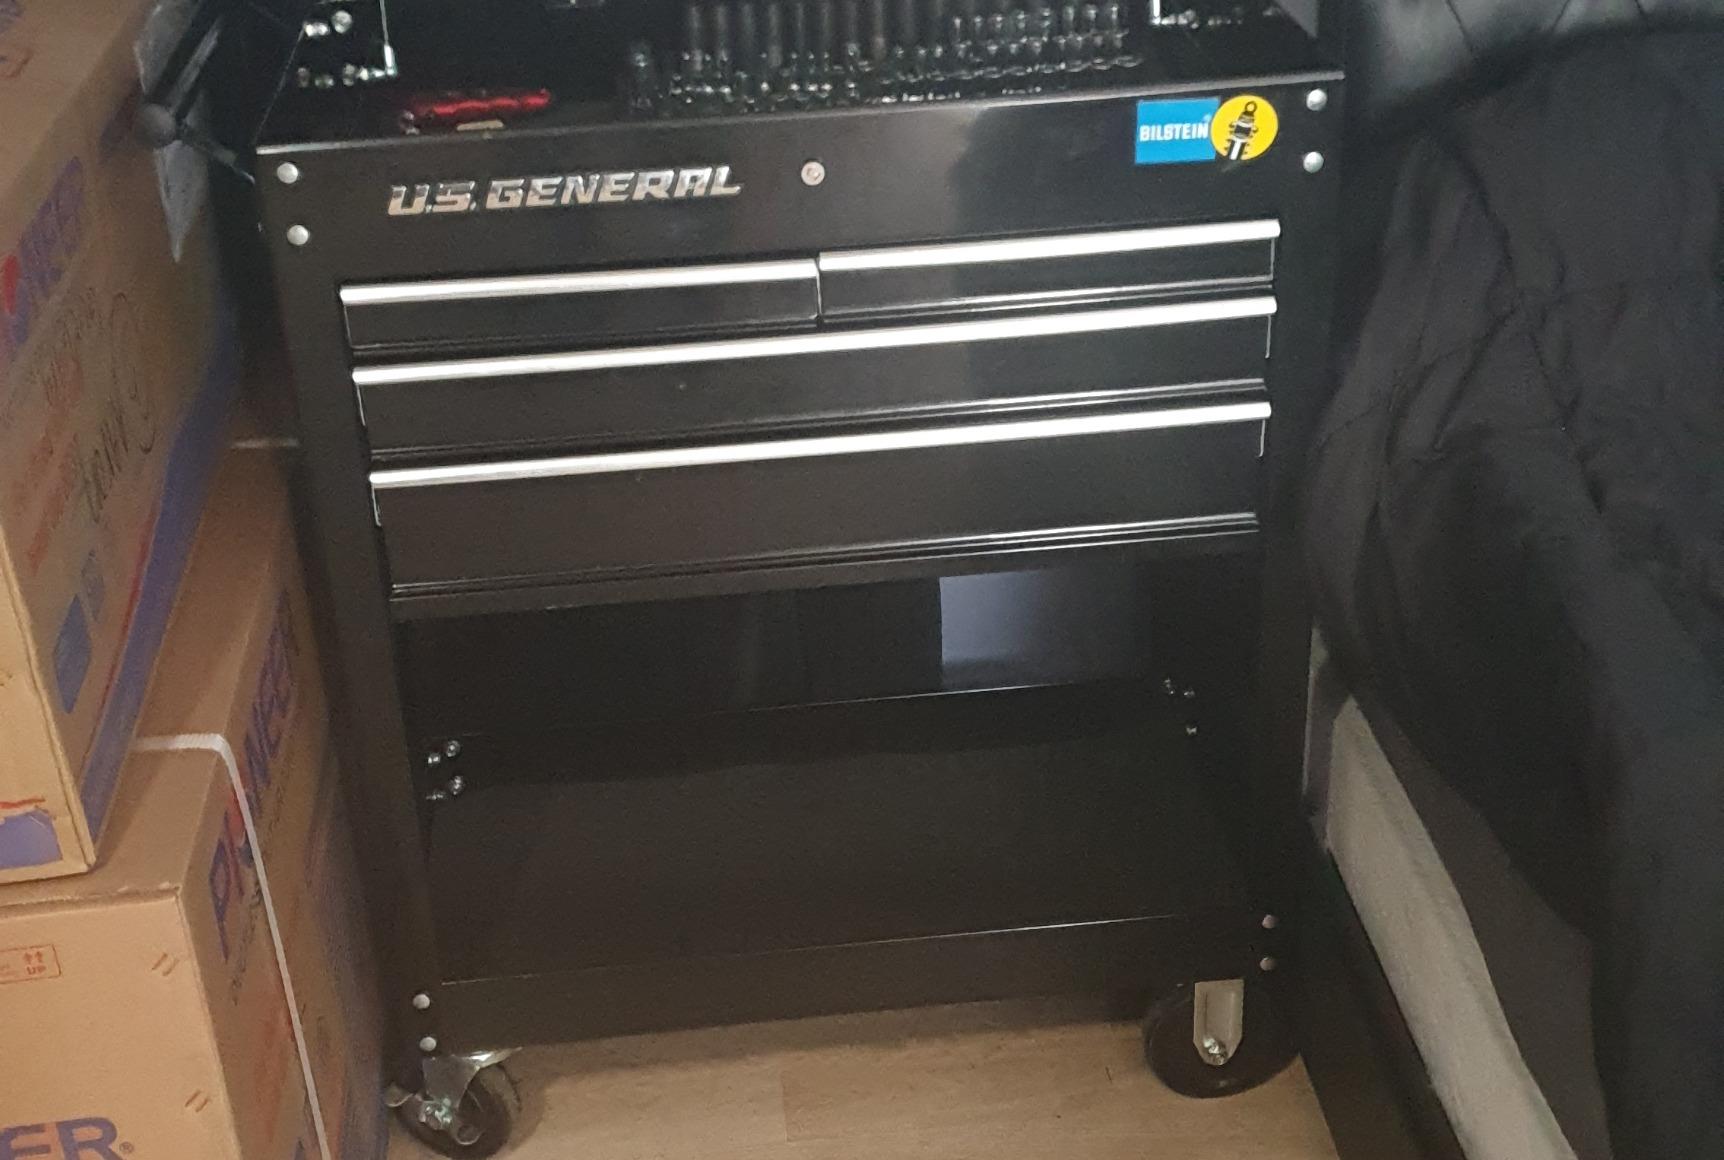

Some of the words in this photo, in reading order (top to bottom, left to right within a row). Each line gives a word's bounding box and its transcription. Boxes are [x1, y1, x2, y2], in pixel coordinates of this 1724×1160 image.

[1139, 122, 1210, 142] BILSTEIN
[387, 181, 477, 216] U.S.
[484, 165, 743, 211] GENERAL
